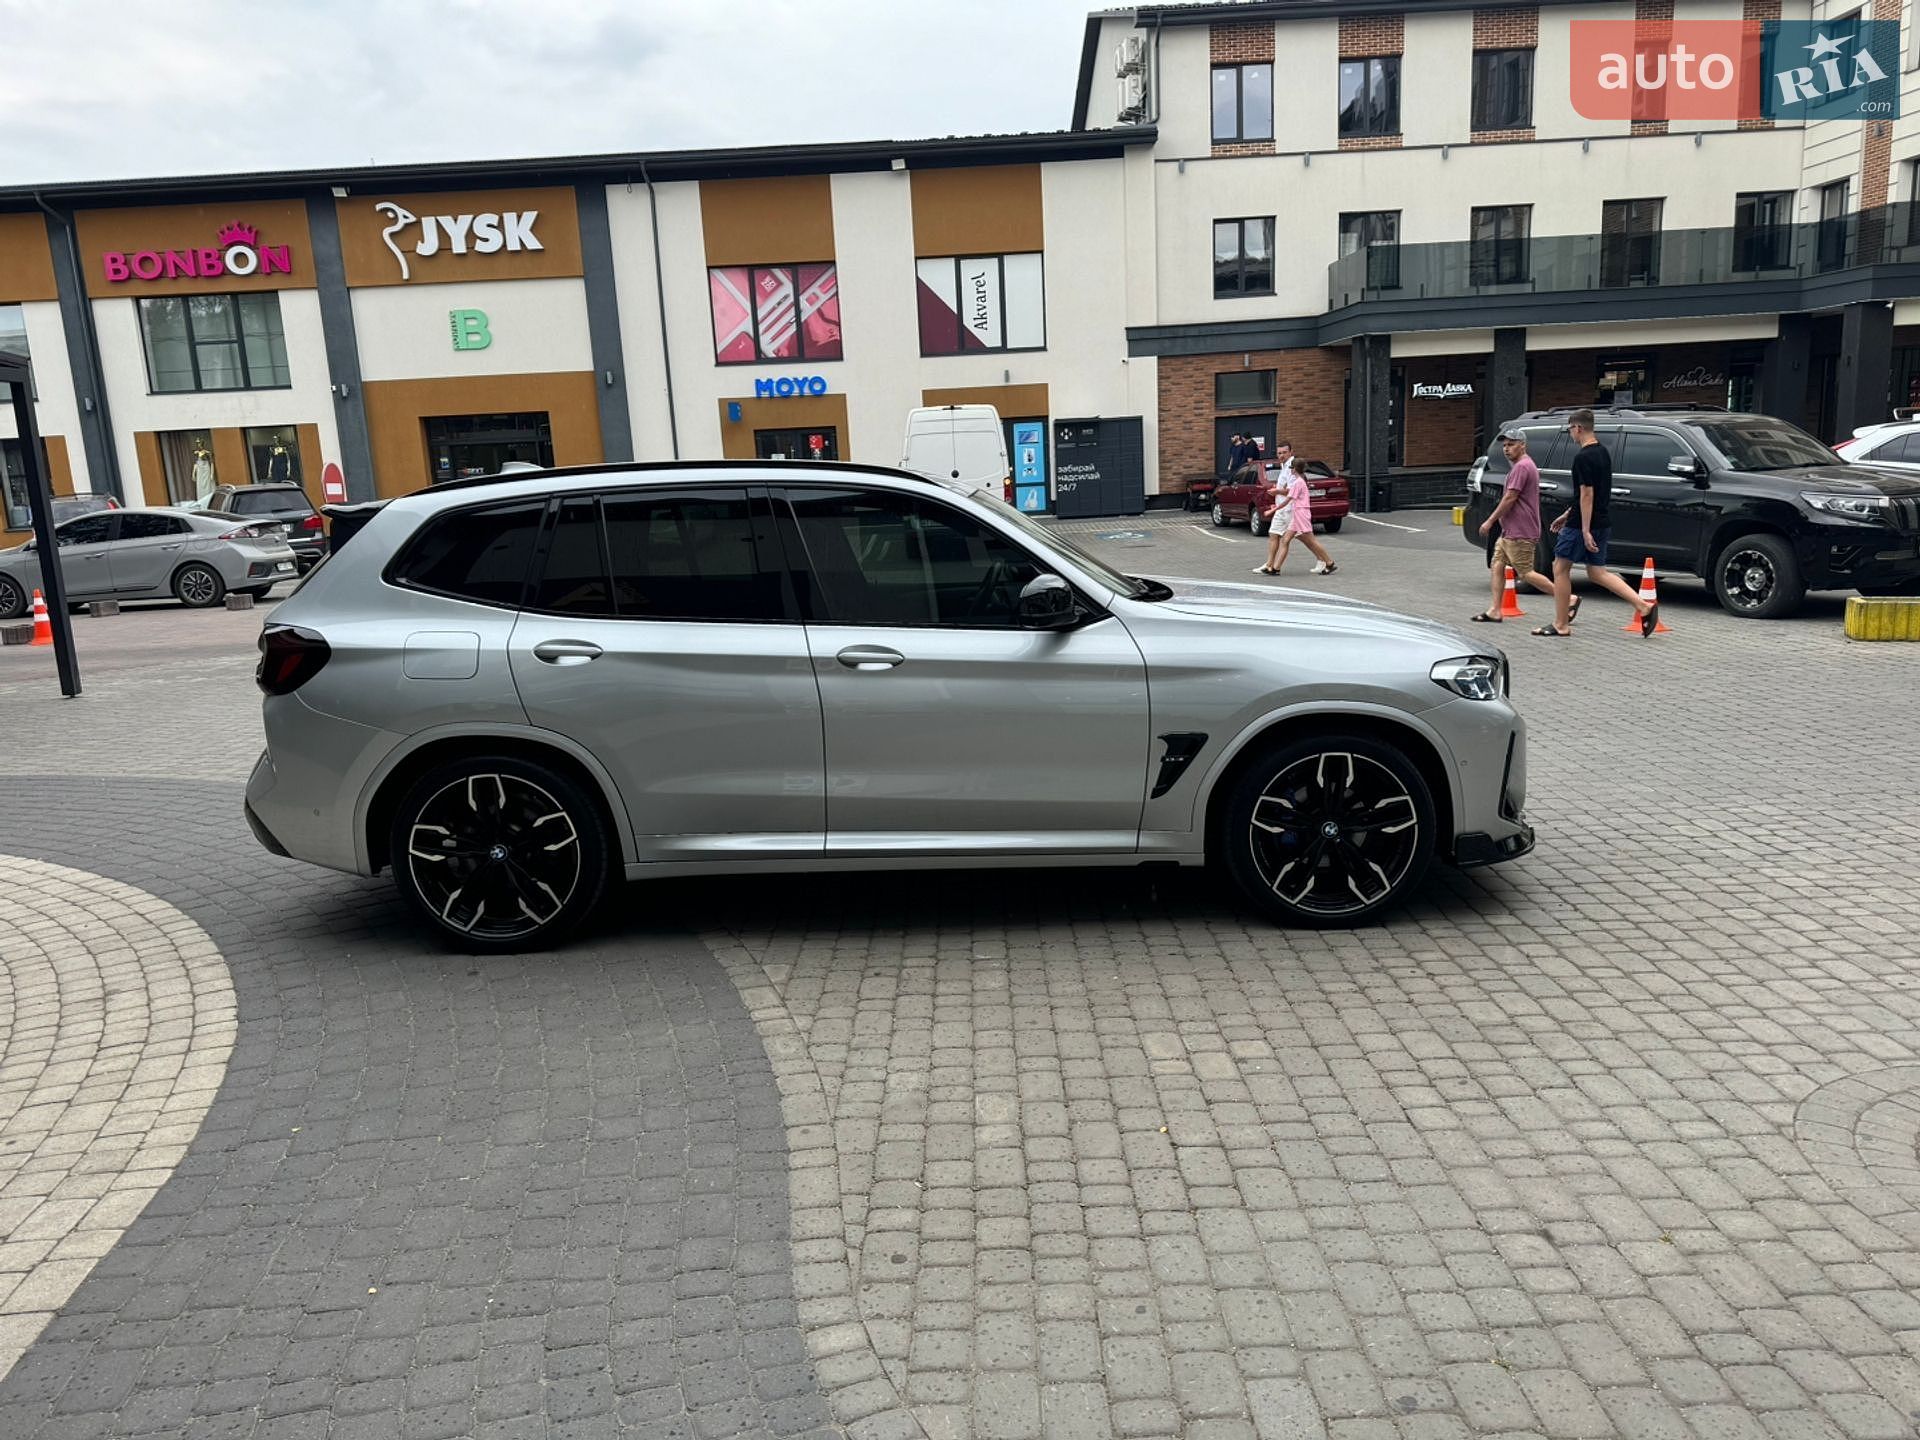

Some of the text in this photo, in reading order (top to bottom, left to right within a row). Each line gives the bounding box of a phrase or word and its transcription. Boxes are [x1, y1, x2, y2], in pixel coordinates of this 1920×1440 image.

[416, 211, 545, 256] JYSK
[104, 245, 292, 282] BONBON
[970, 271, 988, 331] Akvarel
[754, 376, 828, 400] MOYO
[1057, 464, 1095, 473] забирай
[1057, 483, 1077, 492] 24/7
